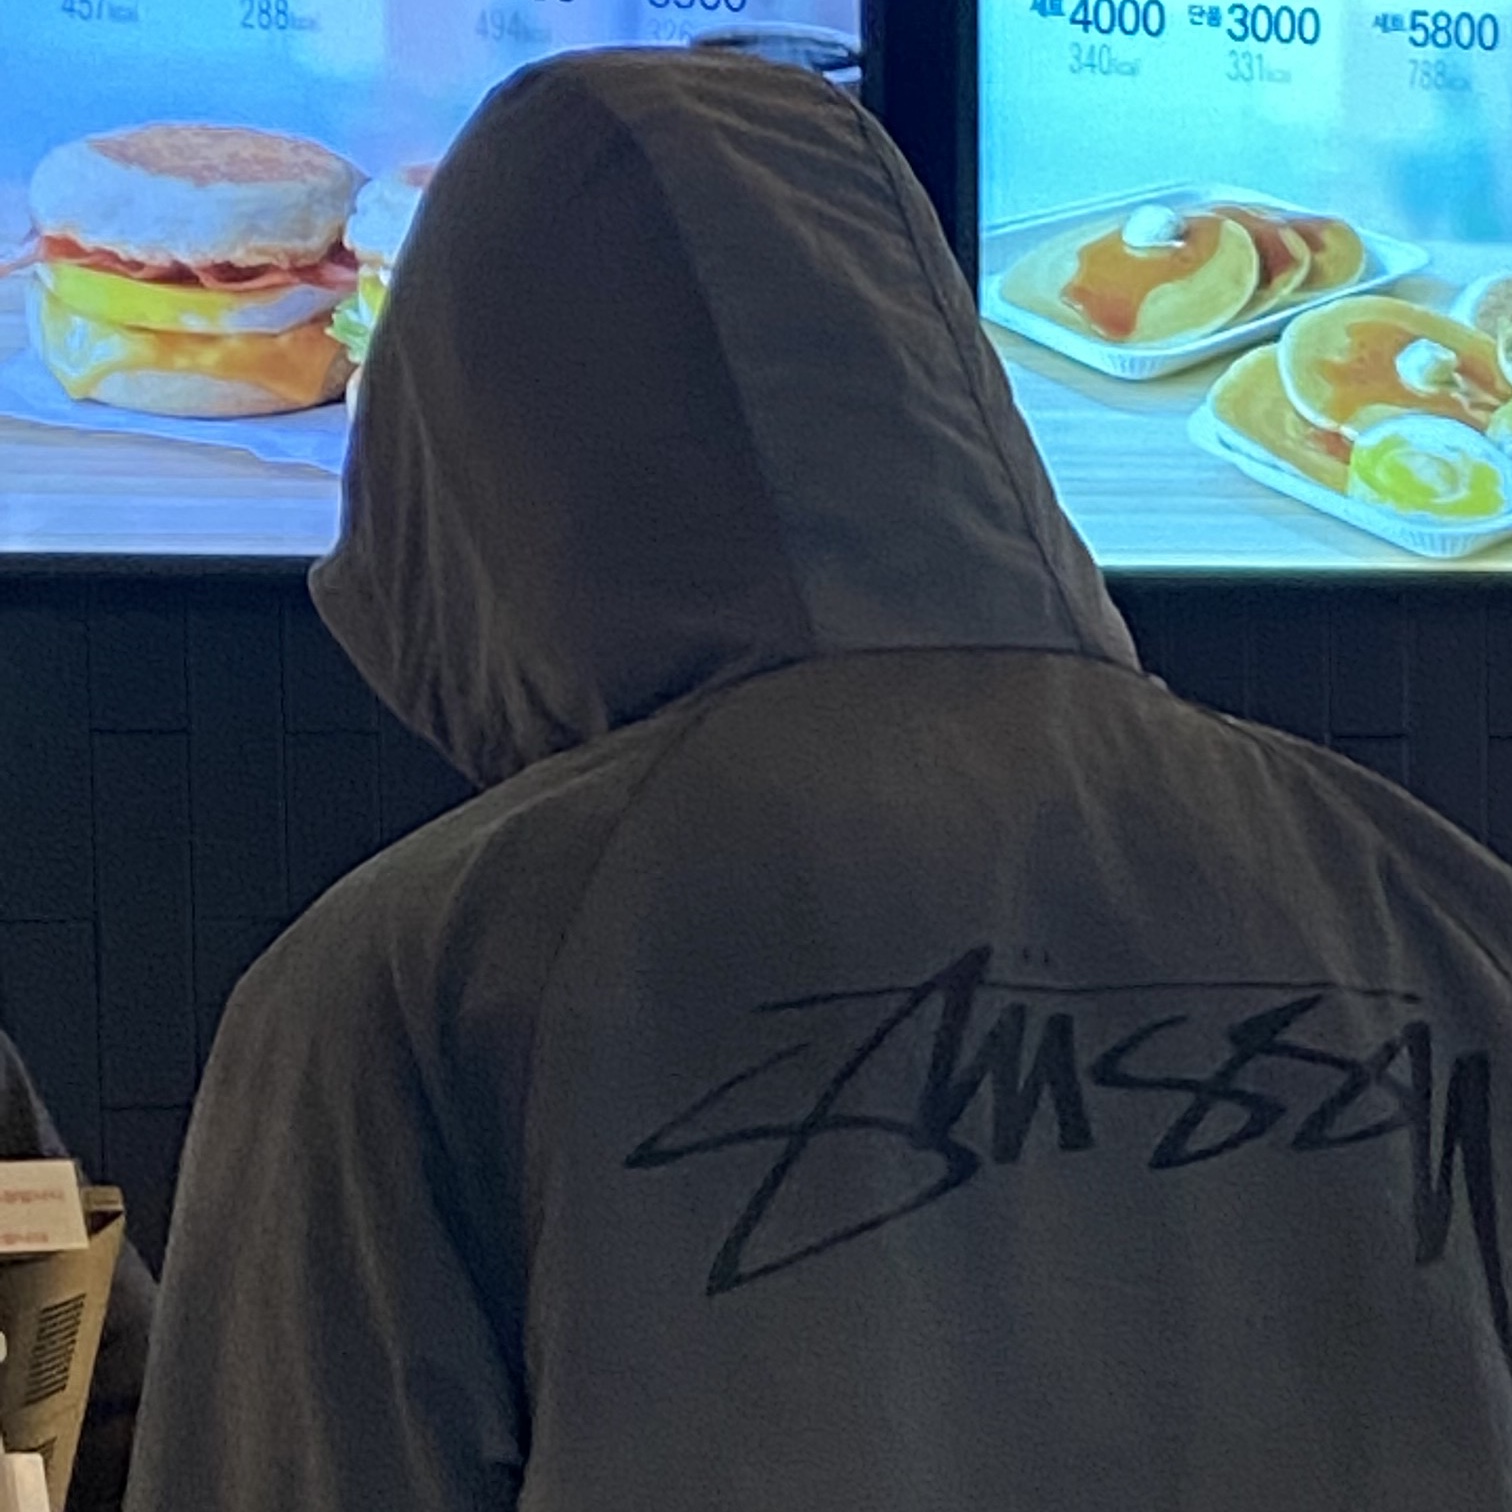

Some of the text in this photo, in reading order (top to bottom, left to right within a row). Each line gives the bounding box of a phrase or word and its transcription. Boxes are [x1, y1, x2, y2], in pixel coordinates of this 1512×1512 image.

[1069, 0, 1166, 37] 4000
[1227, 3, 1322, 45] 3000
[1408, 10, 1499, 51] 5800
